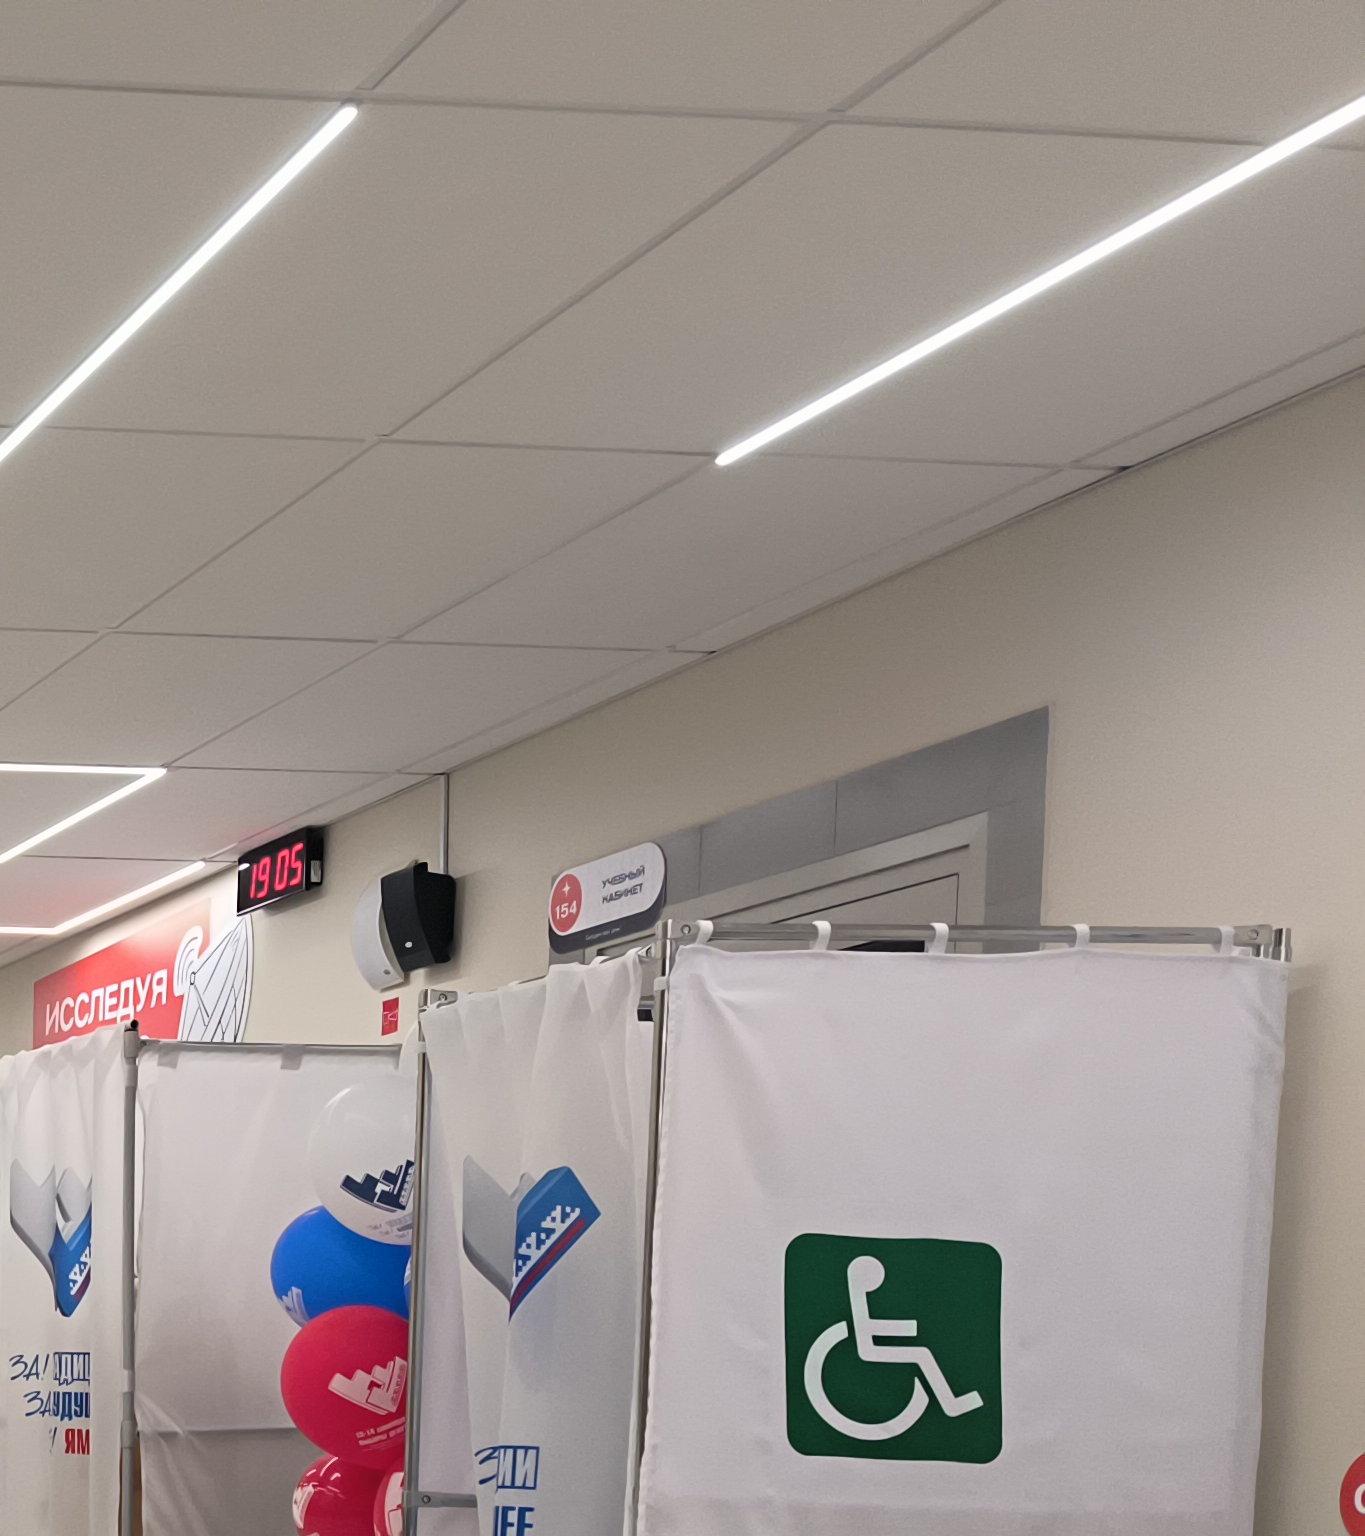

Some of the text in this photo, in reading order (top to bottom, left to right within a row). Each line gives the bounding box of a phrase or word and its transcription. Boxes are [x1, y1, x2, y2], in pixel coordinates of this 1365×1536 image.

[601, 864, 645, 889] УЧЕБНЫЙ
[601, 882, 644, 904] КАБИНЕТ
[555, 900, 578, 920] 154
[45, 968, 168, 1036] ИССЛЕДУЯ
[9, 1353, 50, 1381] ЗА!
